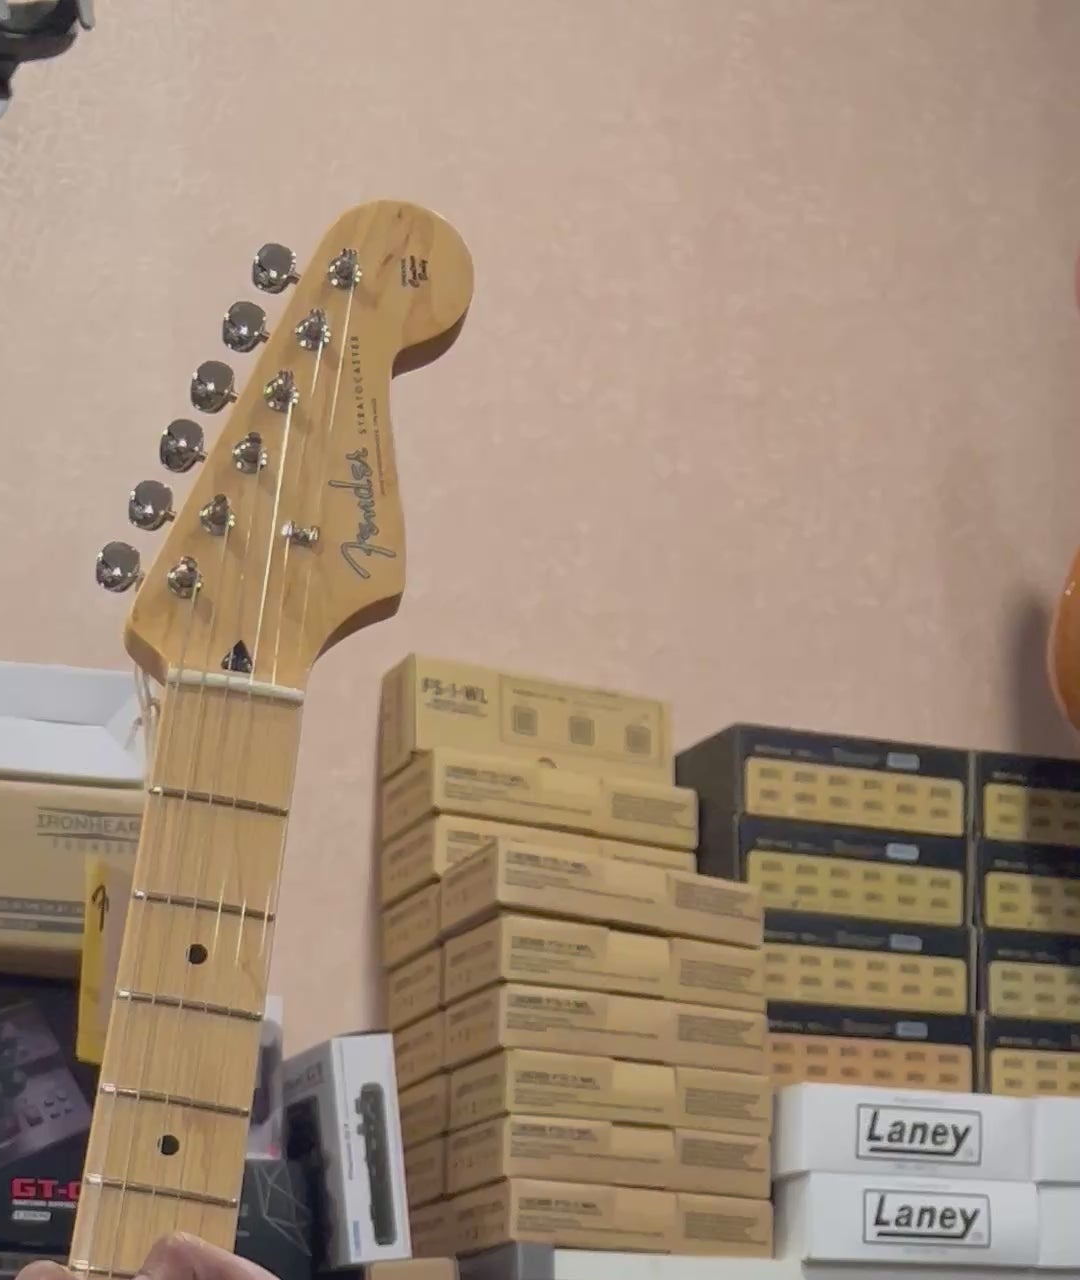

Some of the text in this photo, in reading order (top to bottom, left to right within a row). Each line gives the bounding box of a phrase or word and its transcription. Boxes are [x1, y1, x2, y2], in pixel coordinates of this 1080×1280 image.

[328, 447, 397, 579] Fender
[36, 814, 141, 834] IRONHEAR
[866, 1109, 972, 1157] Laney
[873, 1193, 981, 1240] Laney
